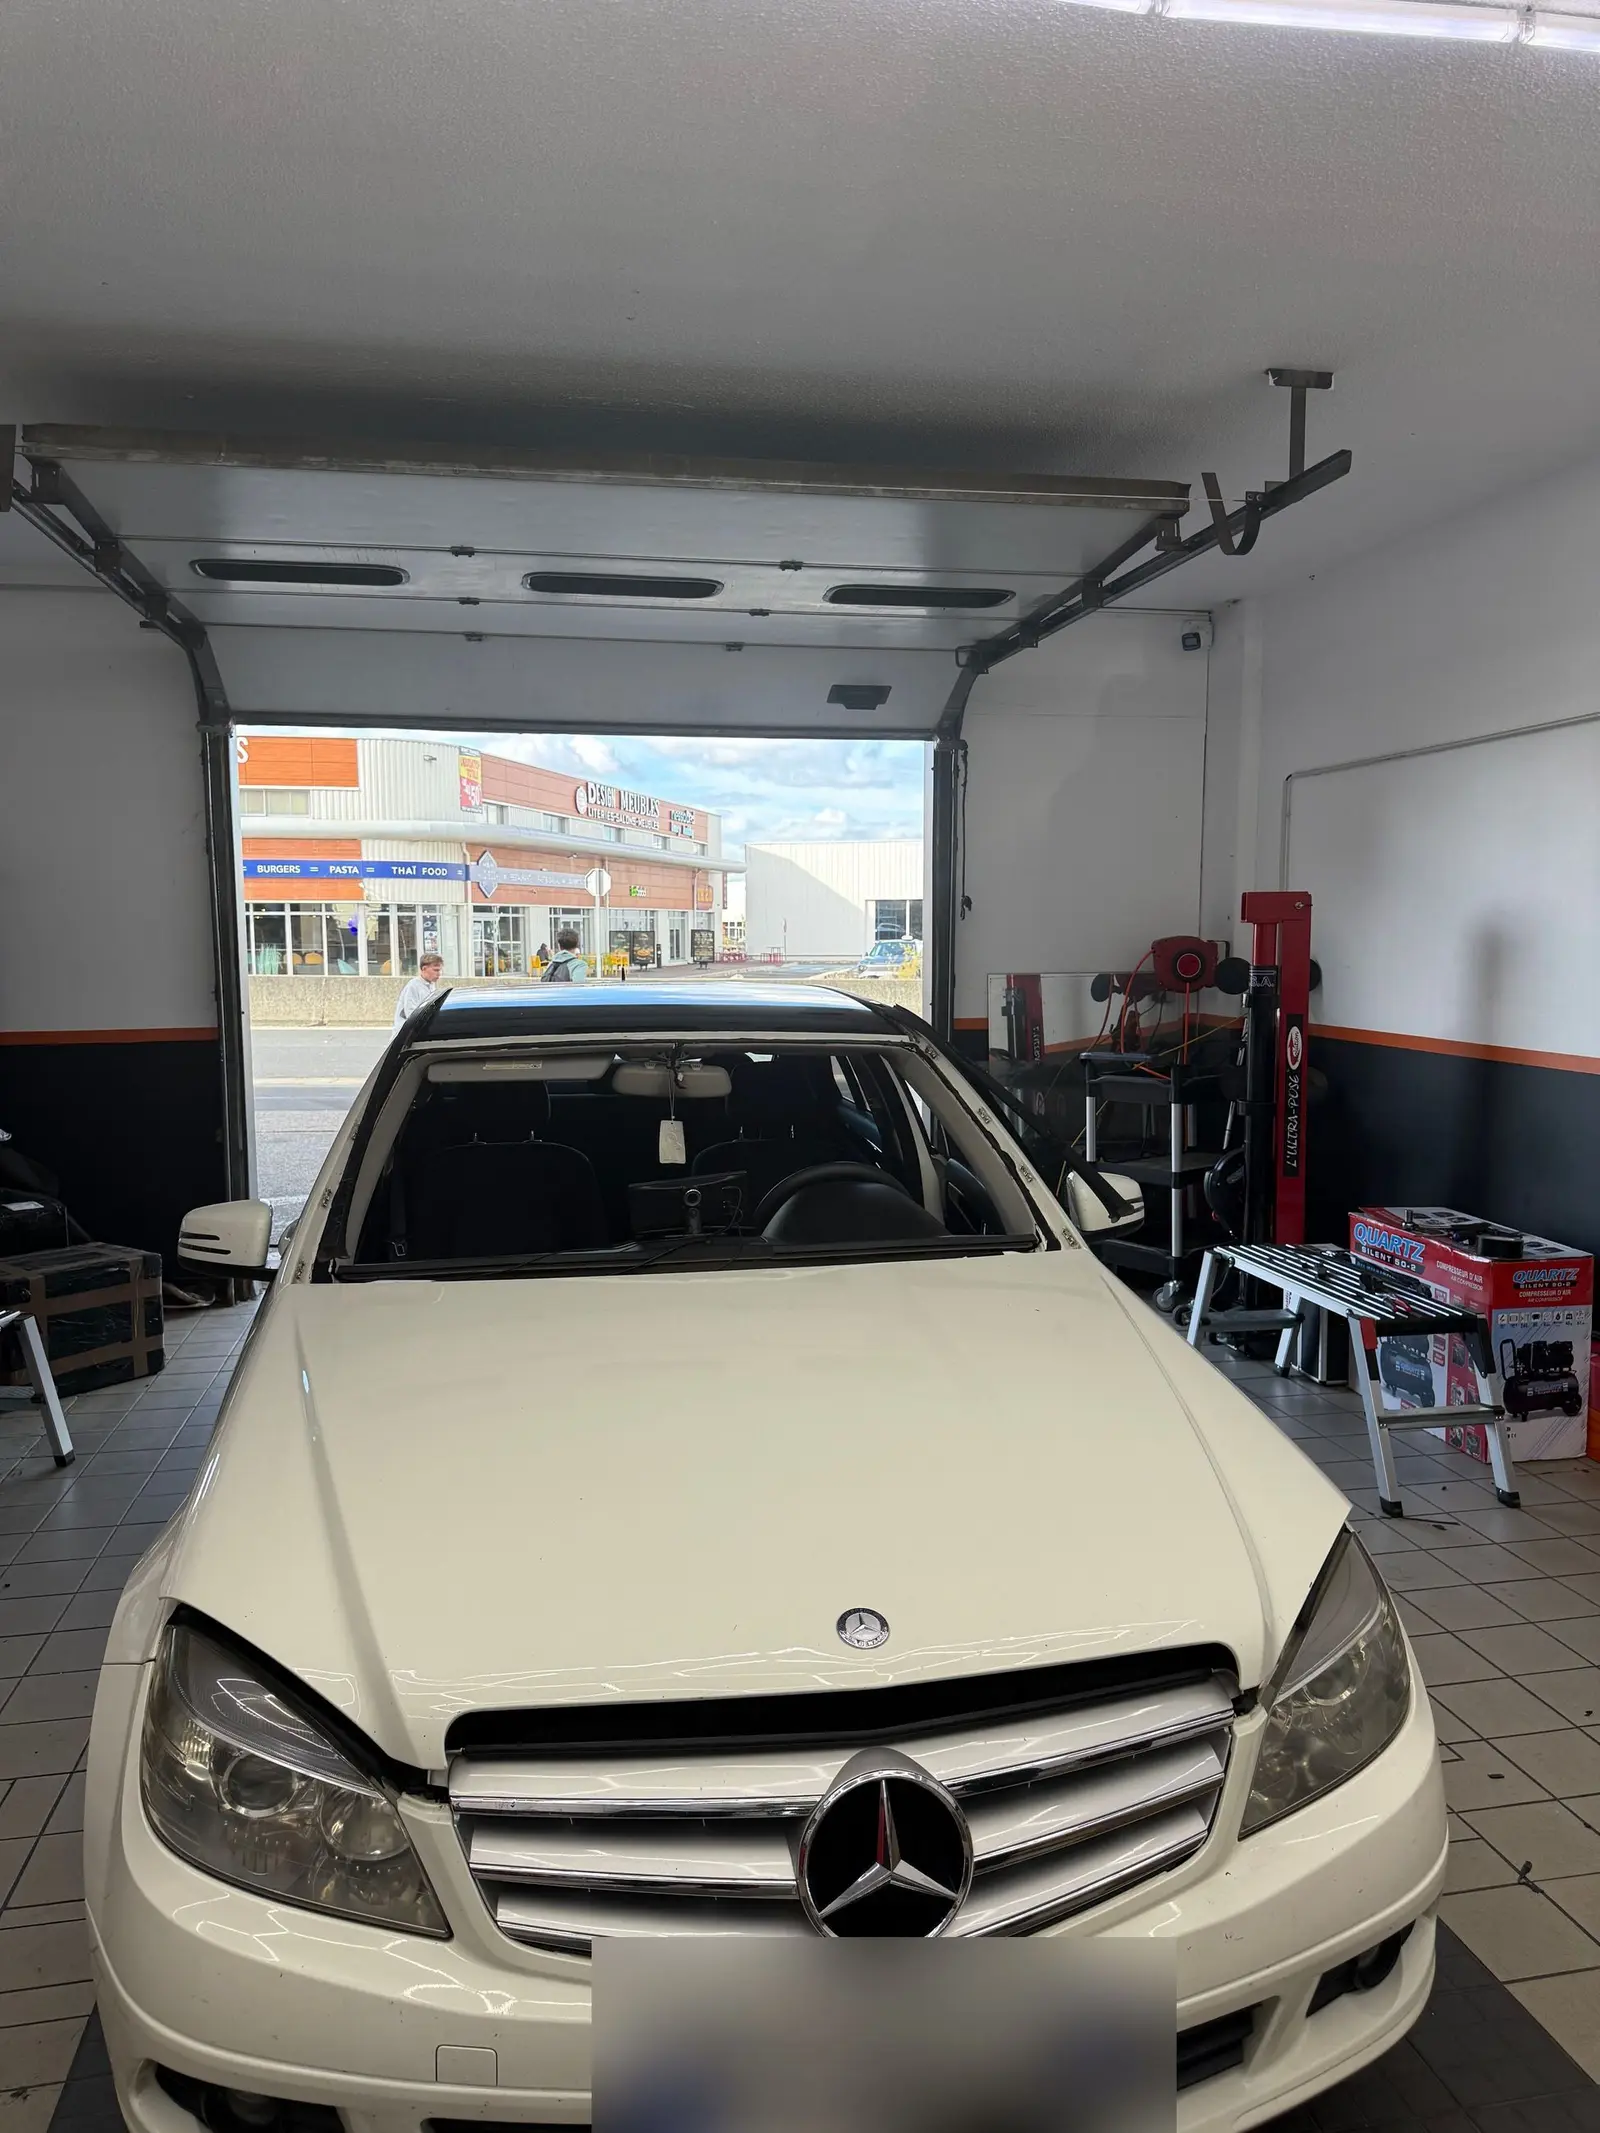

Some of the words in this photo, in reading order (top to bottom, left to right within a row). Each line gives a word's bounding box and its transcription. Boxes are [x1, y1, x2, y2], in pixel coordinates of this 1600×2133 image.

[586, 781, 616, 808] DESIGN
[619, 790, 660, 818] MEUBLES
[256, 864, 301, 874] BURGERS
[329, 865, 360, 875] PASTA
[391, 865, 416, 875] THAÏ
[421, 867, 448, 877] FOOD
[1353, 1222, 1426, 1263] QUARTZ
[1361, 1246, 1392, 1263] SILENT
[1436, 1260, 1469, 1279] COMPRESSEUR
[1469, 1272, 1483, 1284] D'AIR
[1512, 1267, 1580, 1284] QUARTZ
[1519, 1289, 1557, 1298] COMPRESSEUR
